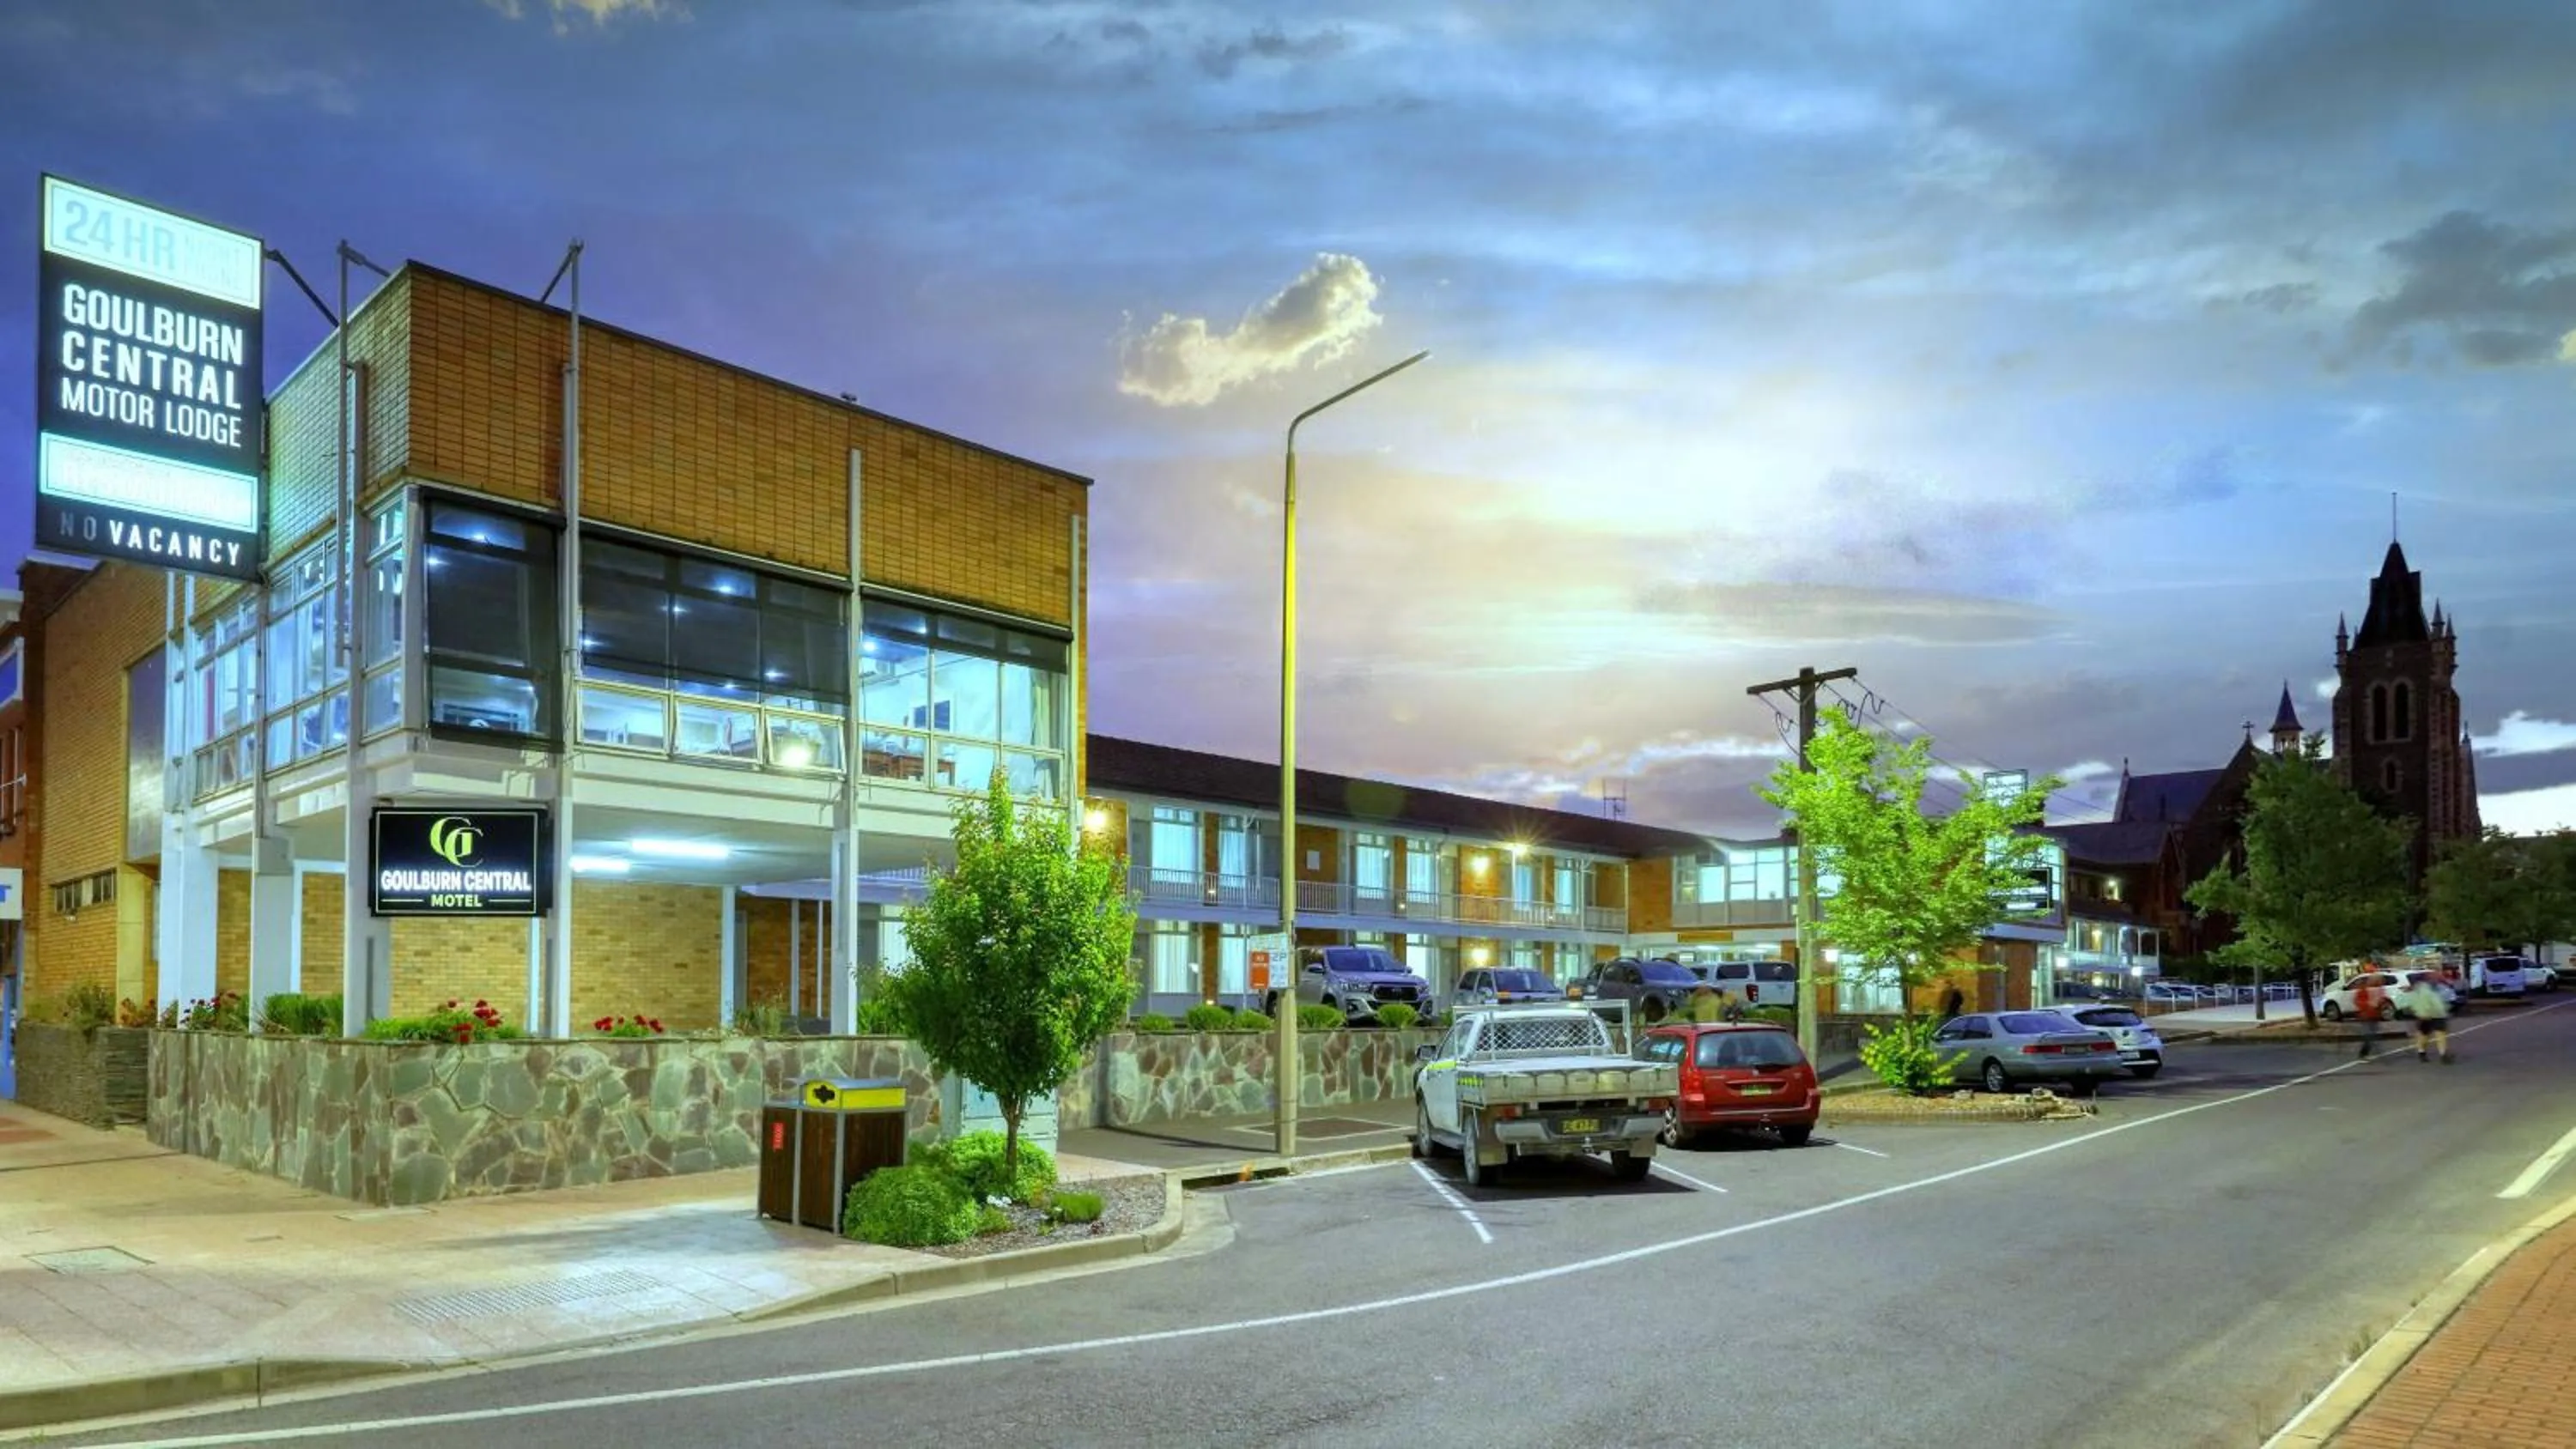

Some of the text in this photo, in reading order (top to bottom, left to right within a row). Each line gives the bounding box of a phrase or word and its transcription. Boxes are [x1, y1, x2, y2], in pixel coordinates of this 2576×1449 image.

[65, 199, 177, 270] 24 HR
[64, 283, 243, 366] GOULBURN
[62, 330, 241, 409] CENTRAL
[61, 378, 241, 447] MOTOR LODGE
[60, 511, 241, 566] NO VACANCY
[381, 870, 532, 891] GOULBURN CENTRAL
[431, 894, 483, 907] MOTEL
